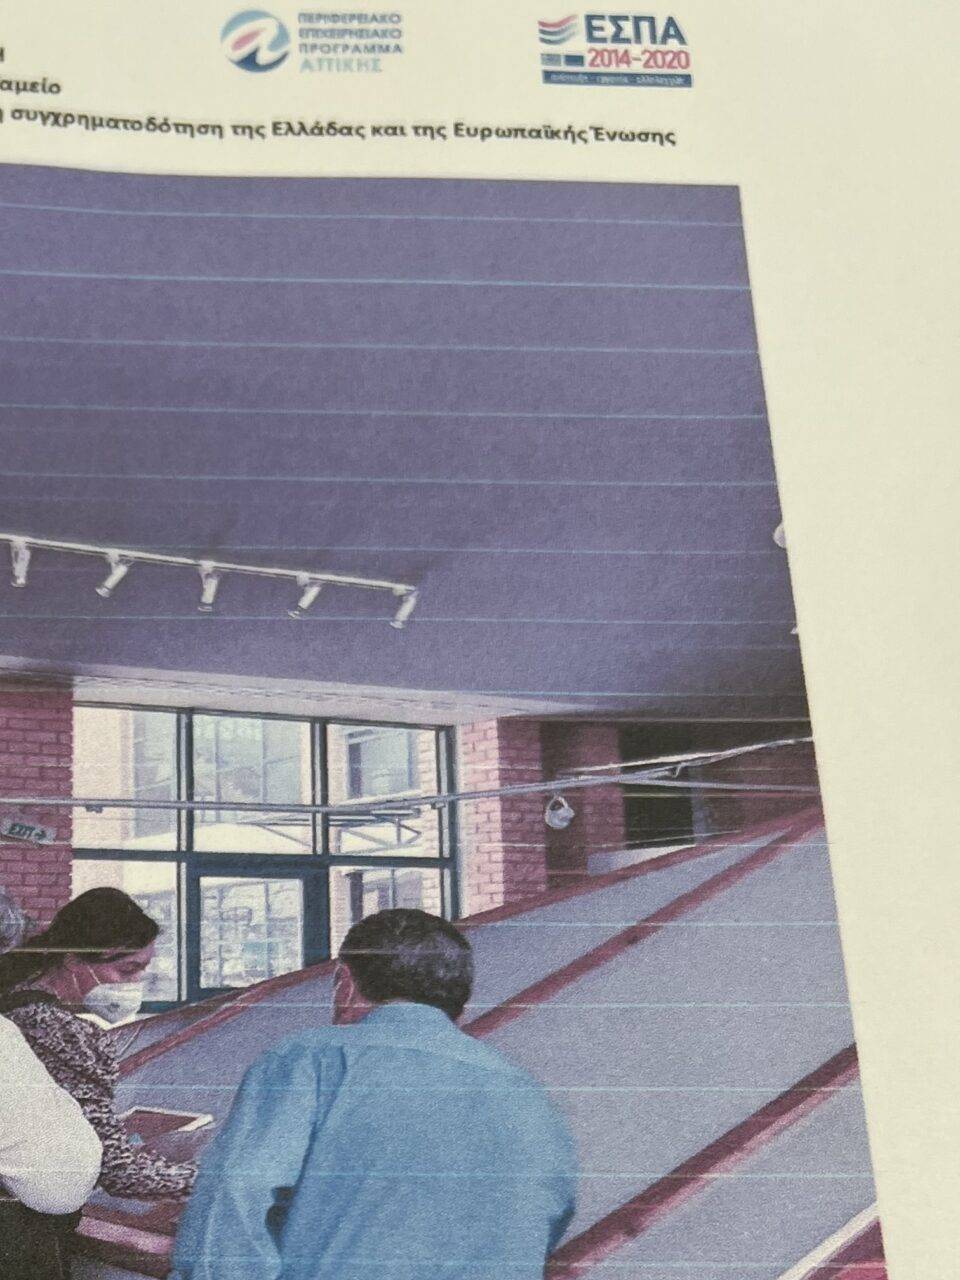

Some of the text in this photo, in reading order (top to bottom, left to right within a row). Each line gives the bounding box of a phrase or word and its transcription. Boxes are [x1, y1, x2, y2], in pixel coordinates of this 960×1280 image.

[584, 14, 689, 46] ΕΣΠΑ
[297, 43, 403, 54] ΠΡΟΓΡΑΜΜΑ
[300, 58, 382, 72] ΑΤΤΙΚΗΣ
[587, 49, 691, 70] 2014-2020
[10, 107, 224, 139] συγχρηματοδότηση
[230, 122, 266, 140] της
[271, 120, 366, 141] Ελλάδας
[370, 124, 407, 137] και
[412, 124, 447, 140] της
[453, 121, 588, 145] Ευρωπαϊκής
[589, 125, 676, 146] Ένωσης
